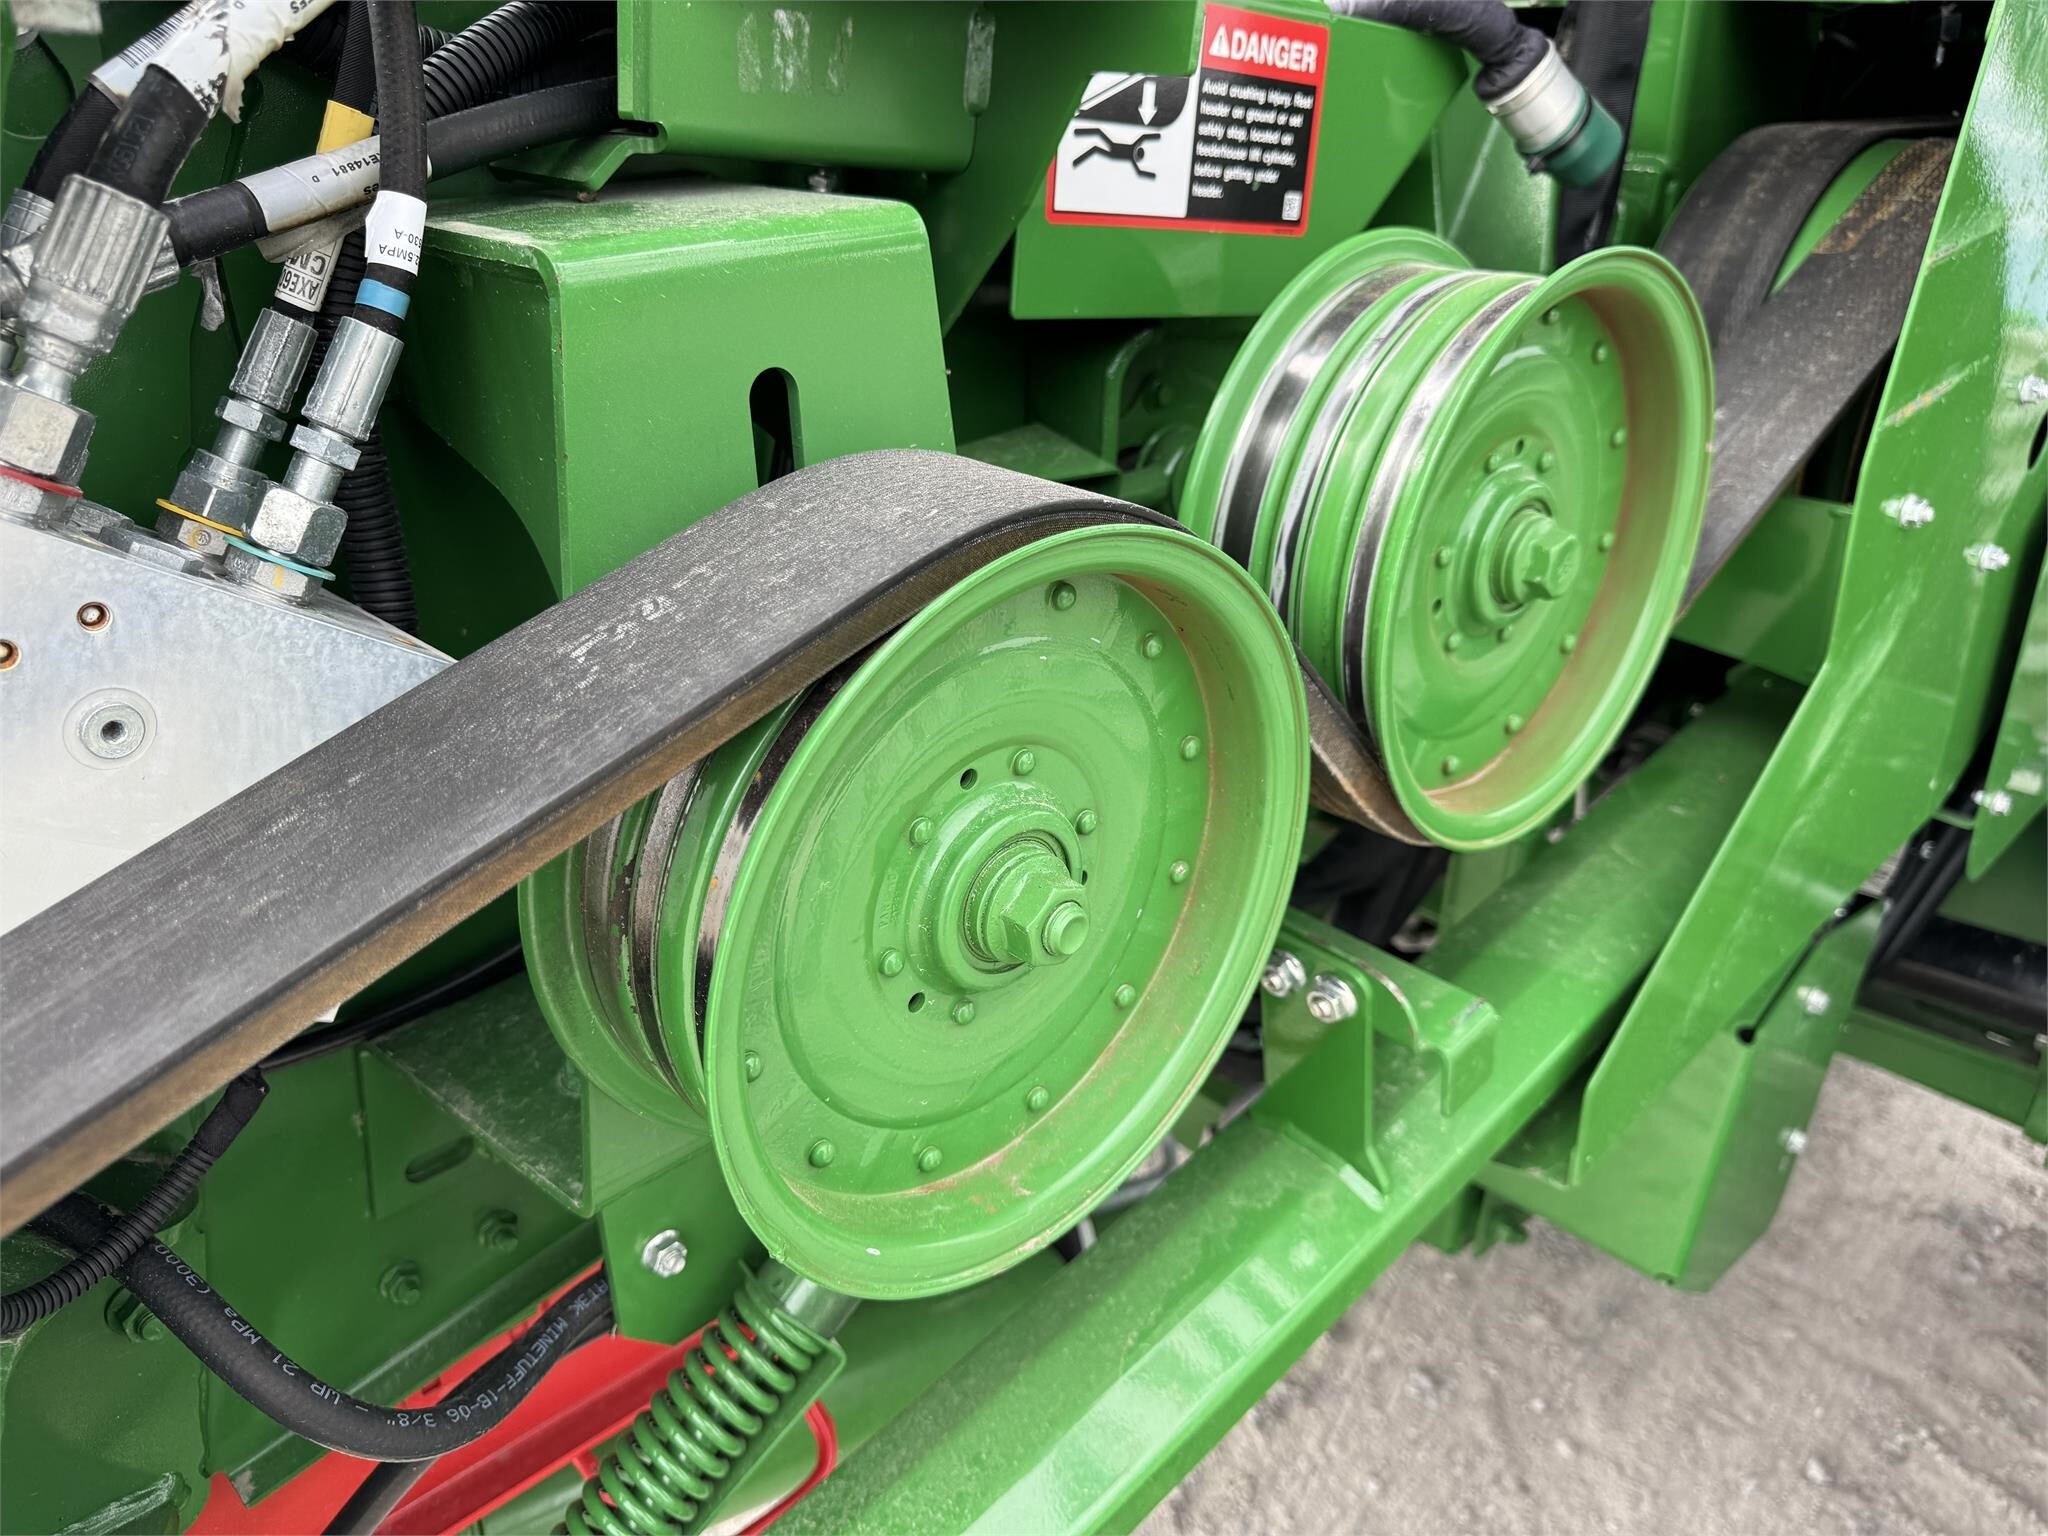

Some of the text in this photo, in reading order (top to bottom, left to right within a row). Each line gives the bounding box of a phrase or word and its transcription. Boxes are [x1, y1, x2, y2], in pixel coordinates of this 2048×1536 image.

[1230, 28, 1318, 74] DANGER
[1202, 79, 1229, 96] Avoid
[1229, 84, 1267, 105] crushing
[1293, 91, 1314, 109] Rest
[1200, 99, 1304, 128] header on ground or set
[1198, 122, 1226, 140] safety
[1250, 126, 1281, 144] located
[1281, 131, 1294, 146] on
[1196, 140, 1248, 161] feederhouse
[1249, 145, 1262, 162] lift
[1194, 160, 1280, 184] before getting under
[224, 1307, 261, 1345] MPa
[272, 1353, 299, 1376] 21
[310, 1381, 341, 1406] WP
[387, 1413, 438, 1428] 3/8"
